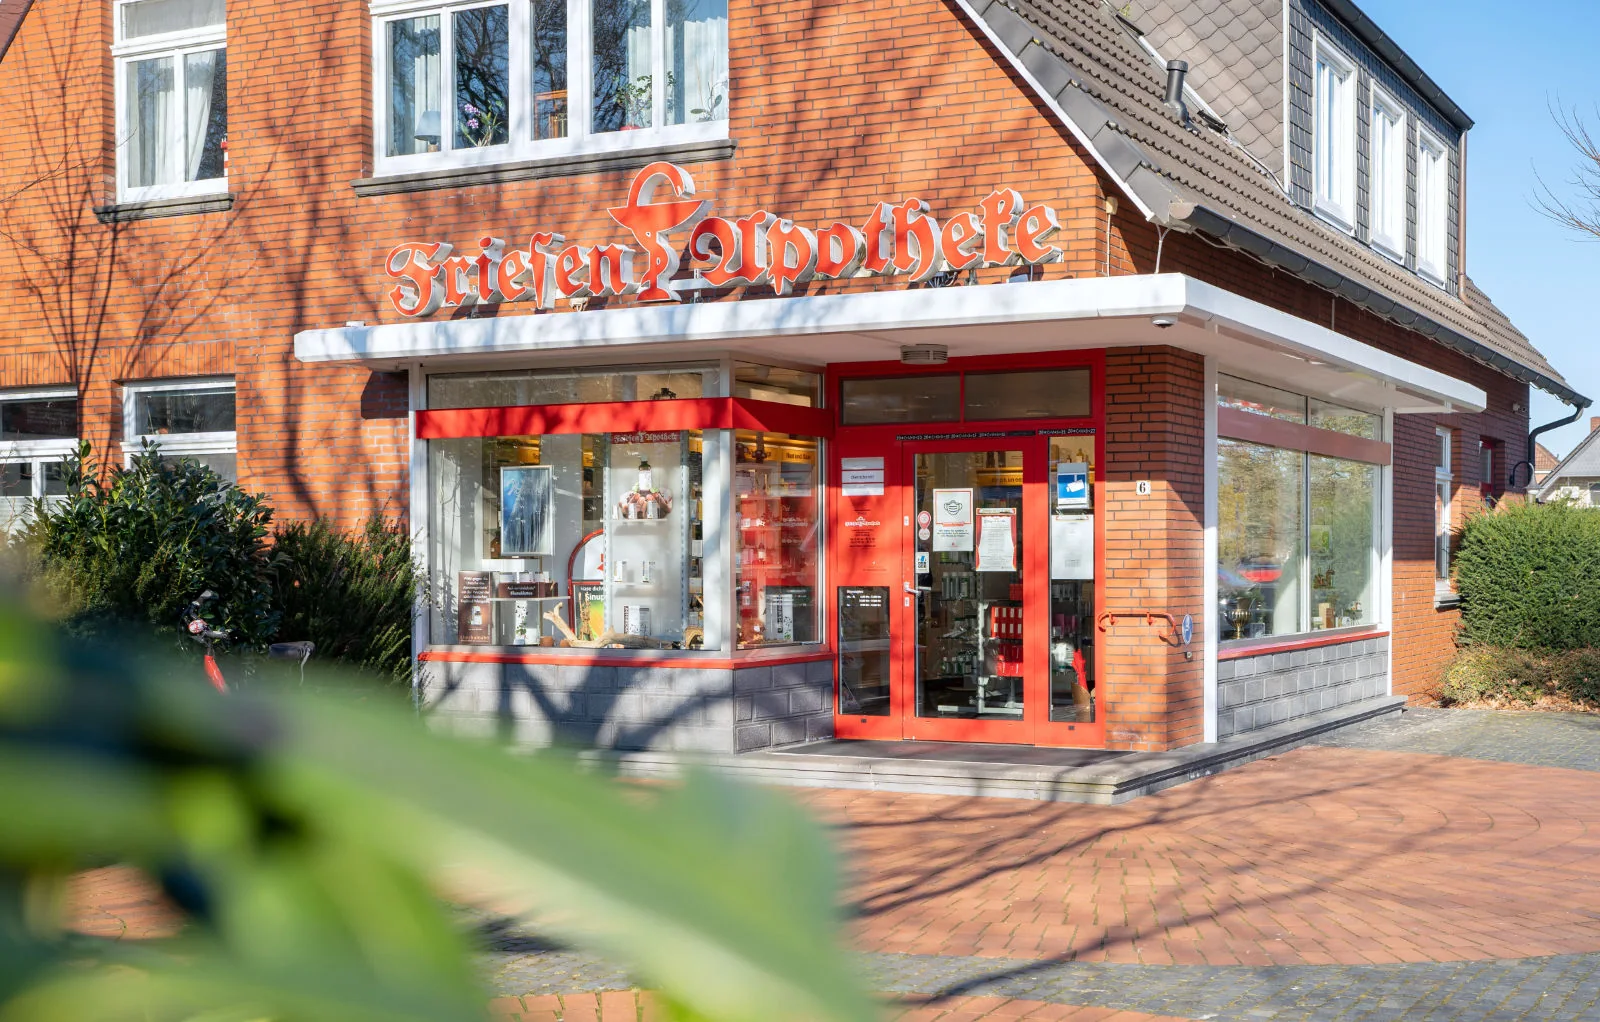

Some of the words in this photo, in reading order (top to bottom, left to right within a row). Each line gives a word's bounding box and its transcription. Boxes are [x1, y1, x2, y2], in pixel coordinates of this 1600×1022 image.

[384, 231, 633, 316] Friesen
[689, 187, 1060, 296] Apotheke
[1139, 481, 1146, 494] 6
